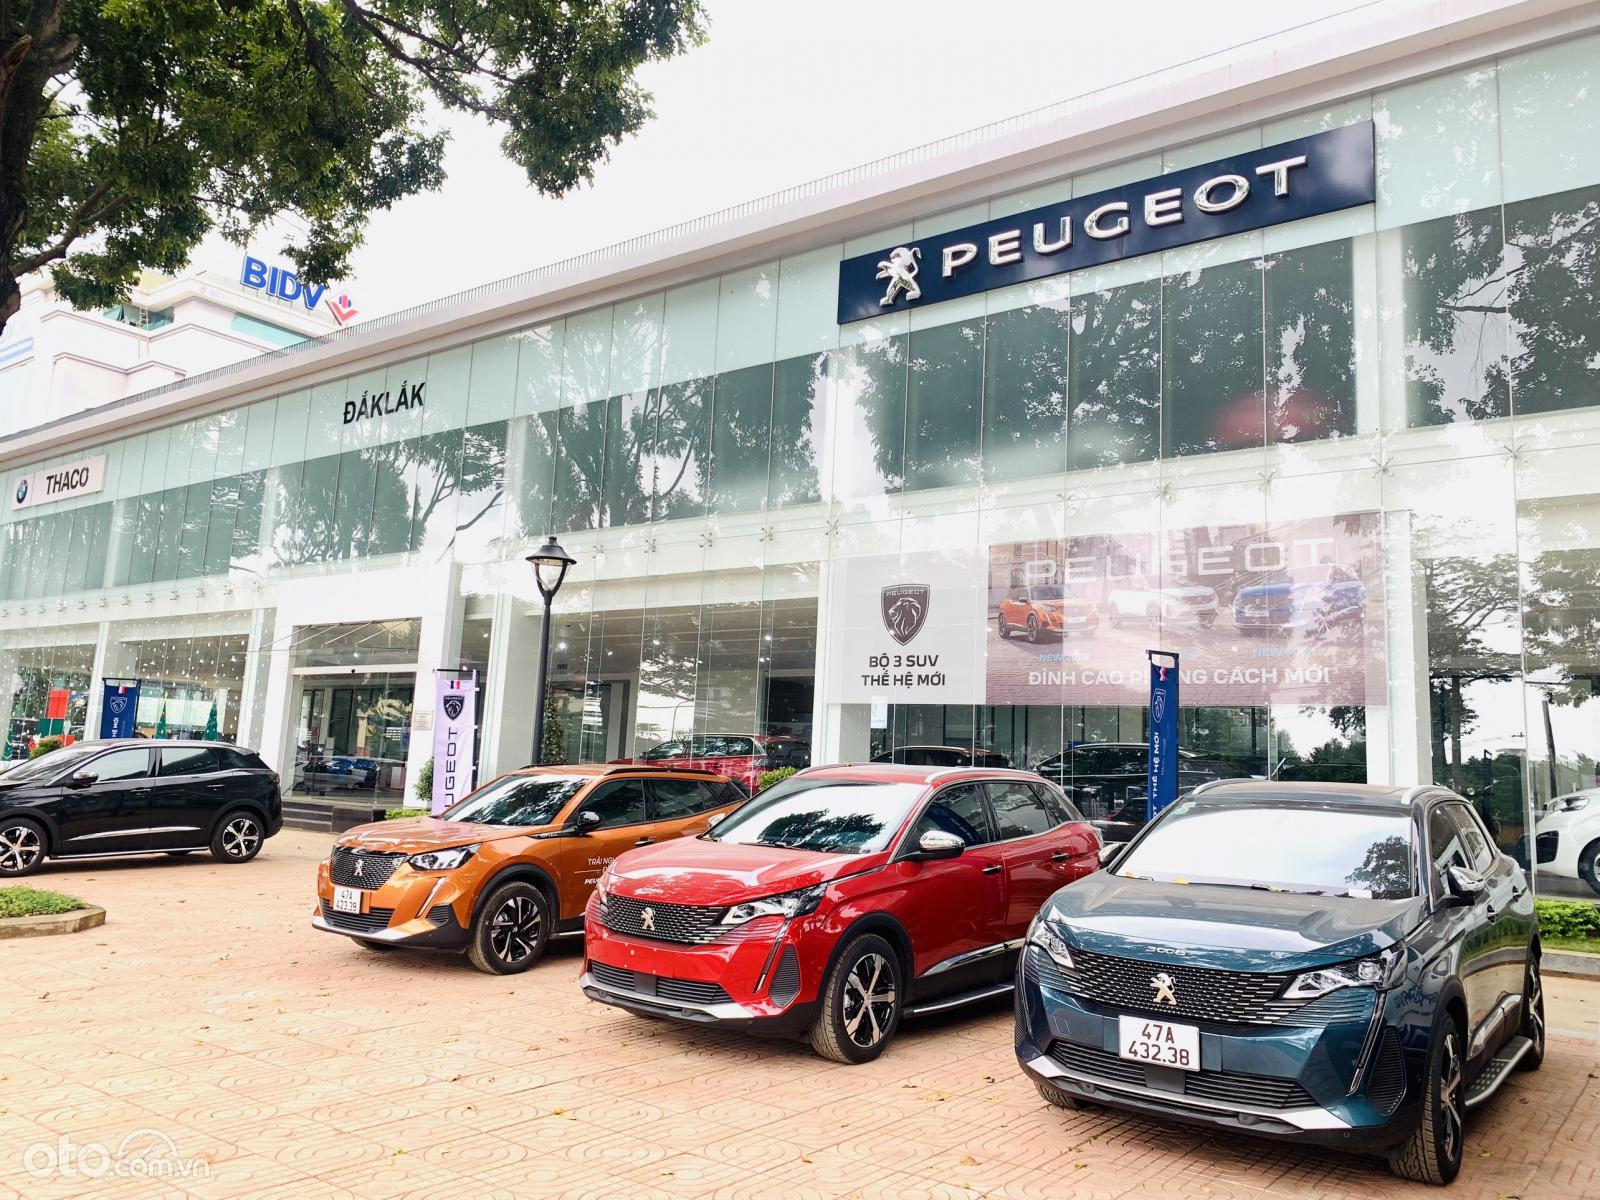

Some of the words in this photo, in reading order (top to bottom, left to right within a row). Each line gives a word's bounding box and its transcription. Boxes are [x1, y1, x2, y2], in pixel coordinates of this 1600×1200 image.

[942, 155, 1306, 278] PEUGEOT
[240, 255, 326, 310] BIDV
[343, 380, 426, 424] ĐẮKLẮK
[46, 466, 90, 495] THACO
[885, 589, 925, 597] PEUGEOT
[869, 653, 890, 671] BỘ
[894, 655, 902, 668] 3
[906, 655, 939, 667] SUV
[861, 670, 890, 686] THẾ
[893, 672, 913, 689] HỆ
[917, 671, 946, 686] MỚI
[1213, 666, 1278, 684] CÁCH
[1142, 1023, 1174, 1044] 47A
[1128, 1041, 1190, 1066] 432.38
